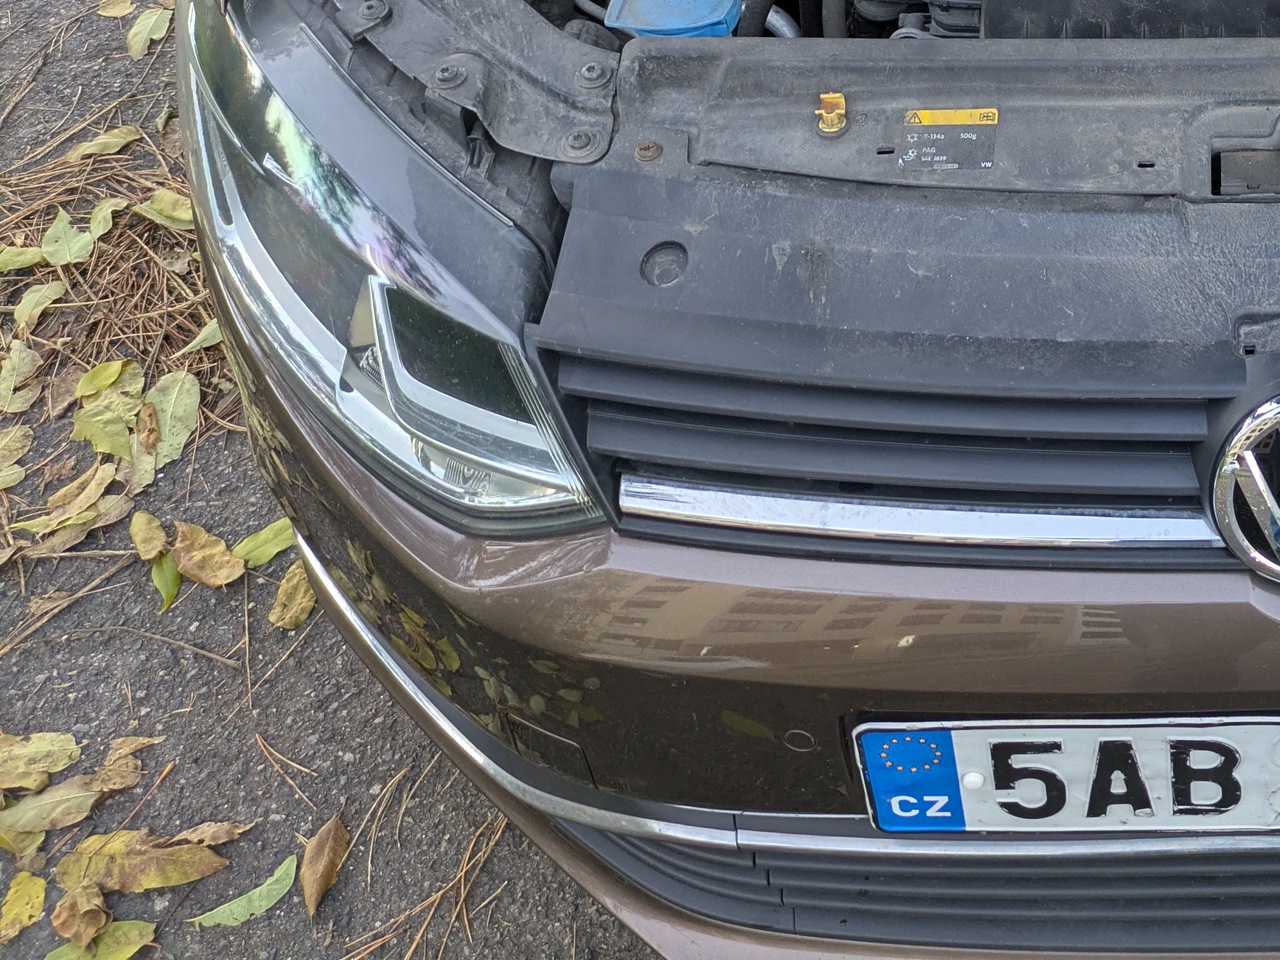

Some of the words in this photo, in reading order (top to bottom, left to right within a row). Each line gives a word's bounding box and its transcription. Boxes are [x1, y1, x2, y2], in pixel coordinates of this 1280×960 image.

[960, 133, 977, 141] 500g
[988, 738, 1243, 820] 5AB
[890, 794, 952, 818] CZ
